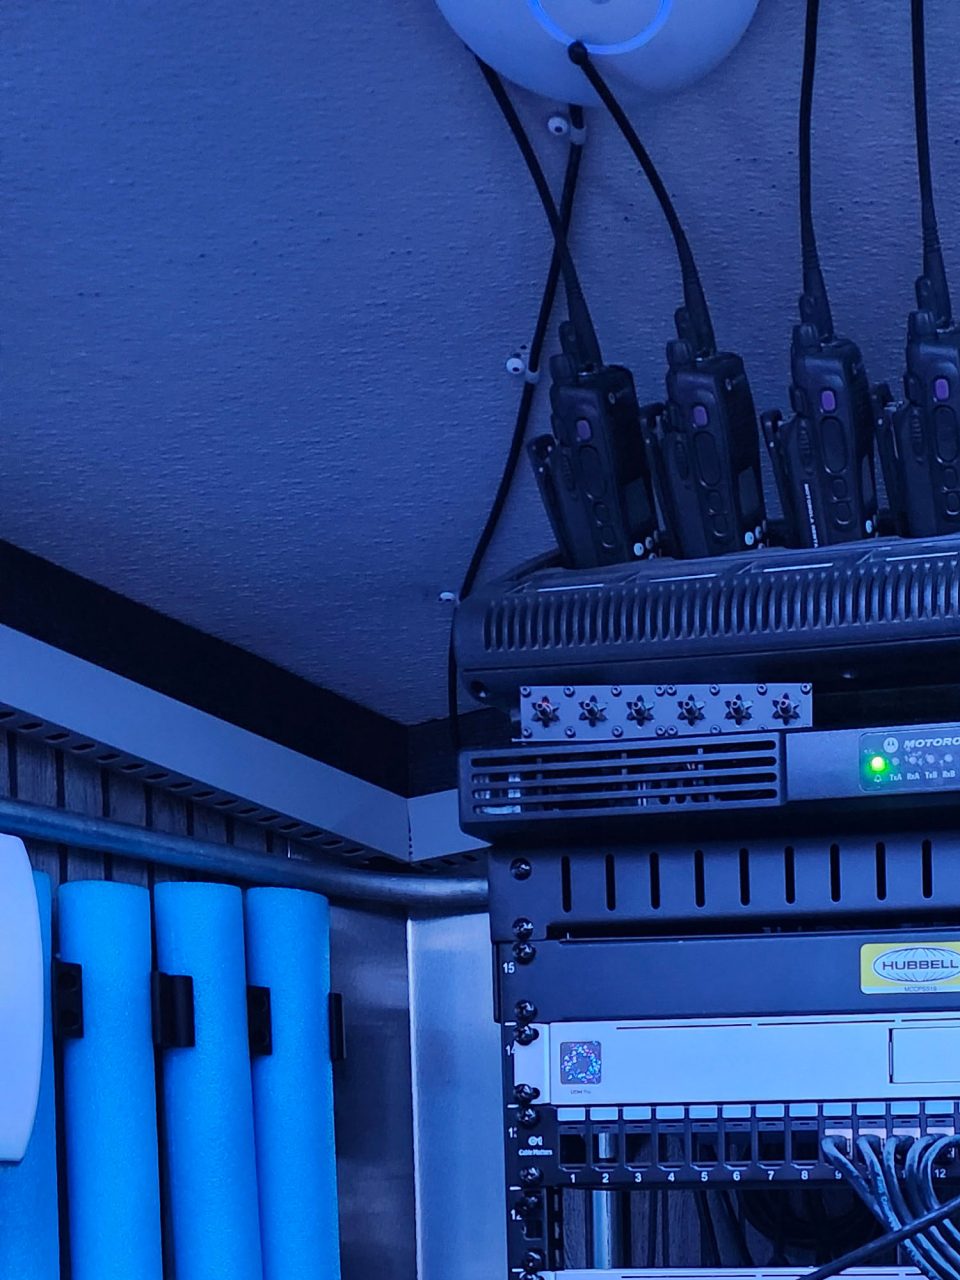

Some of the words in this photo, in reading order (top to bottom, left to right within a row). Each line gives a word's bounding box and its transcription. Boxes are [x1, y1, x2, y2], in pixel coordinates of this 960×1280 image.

[803, 483, 815, 523] MOTOROLA
[503, 962, 515, 974] 15
[882, 960, 959, 971] HUBBELL
[571, 1174, 576, 1183] 1
[602, 1173, 609, 1183] 2
[635, 1172, 642, 1182] 3
[668, 1172, 675, 1182] 4
[701, 1171, 708, 1181] 5
[733, 1171, 741, 1181] 6
[768, 1171, 775, 1180] 7
[801, 1170, 809, 1180] 8
[935, 1169, 946, 1178] 12
